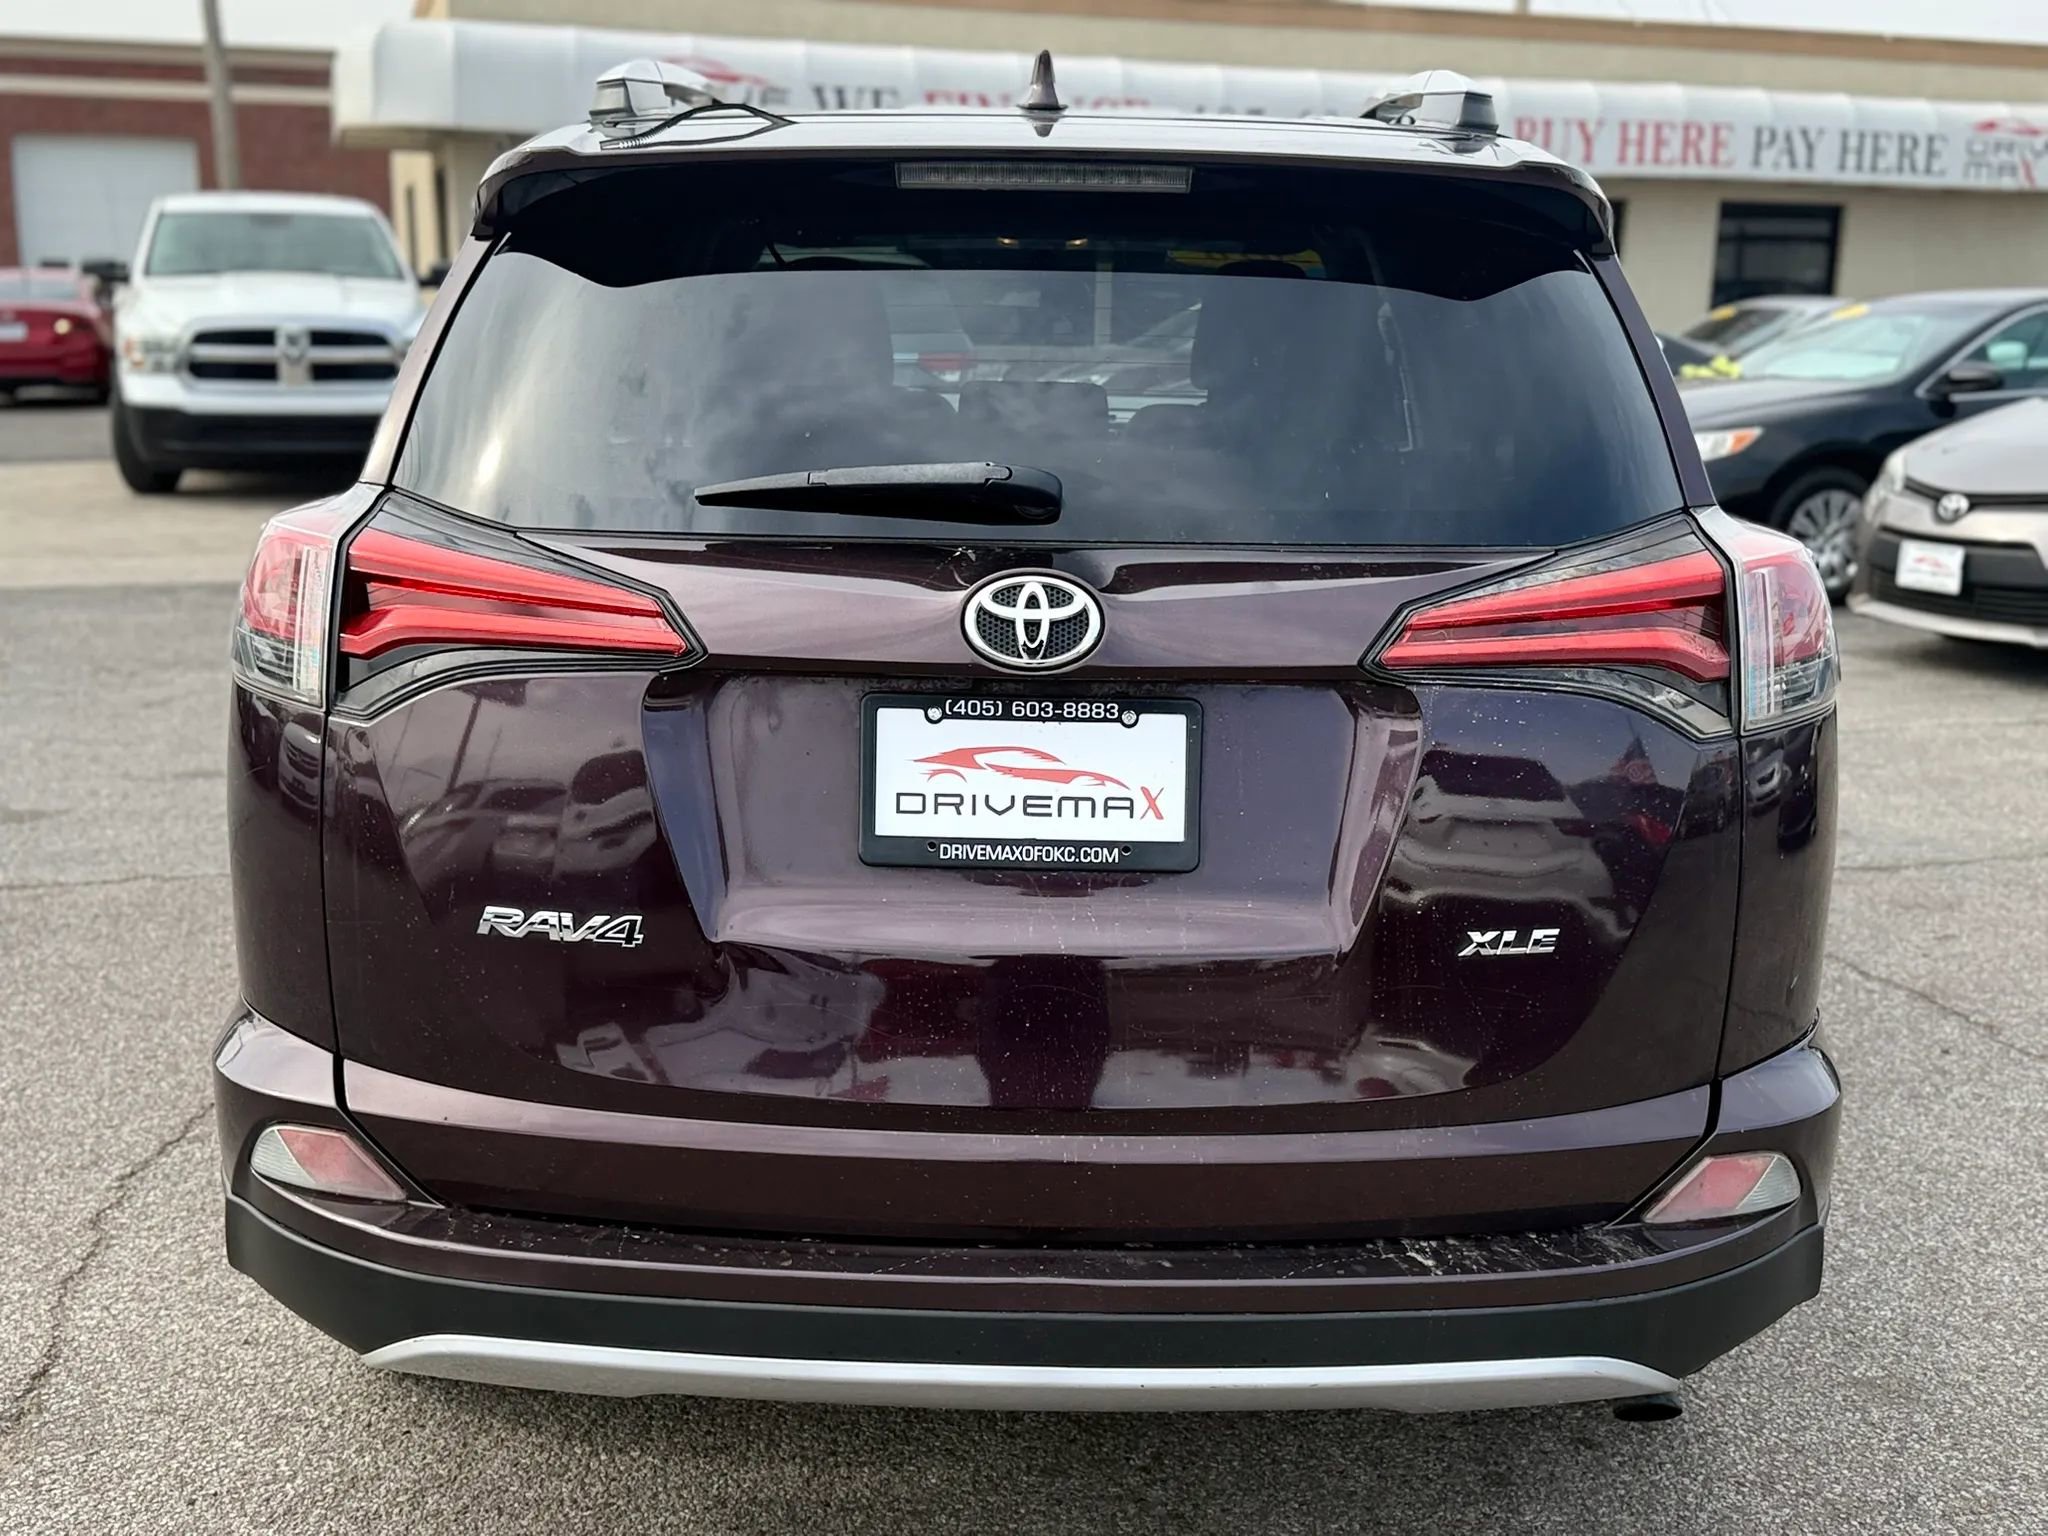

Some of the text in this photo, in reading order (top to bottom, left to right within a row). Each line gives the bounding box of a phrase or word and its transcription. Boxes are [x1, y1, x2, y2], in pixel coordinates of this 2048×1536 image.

[1616, 119, 1736, 167] HERE
[1751, 125, 1825, 170] PAY
[1837, 128, 1950, 177] HERE
[945, 699, 1119, 720] (405) 603-8883
[896, 786, 1164, 820] DRIVEMAX
[939, 844, 1120, 863] DRIVEMAXOFOKC.COM
[476, 905, 644, 947] RAV4
[1458, 928, 1560, 956] XLE
